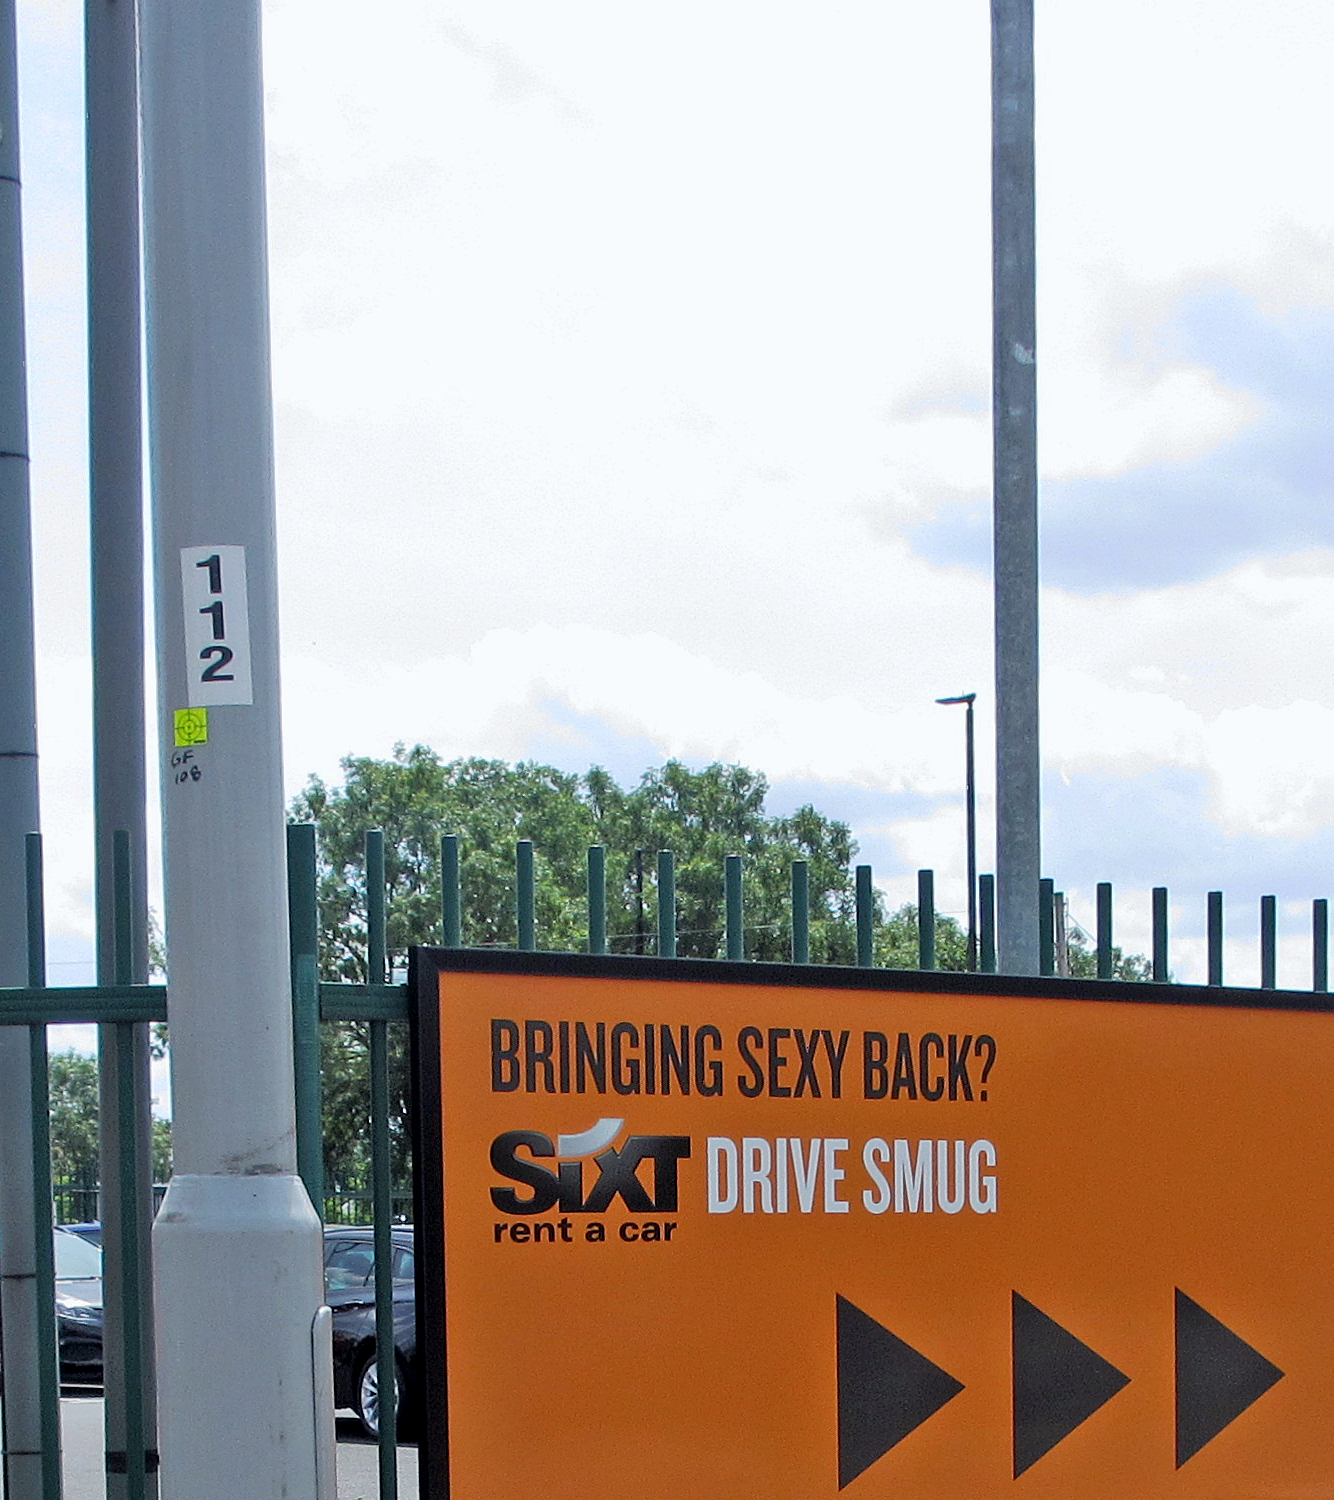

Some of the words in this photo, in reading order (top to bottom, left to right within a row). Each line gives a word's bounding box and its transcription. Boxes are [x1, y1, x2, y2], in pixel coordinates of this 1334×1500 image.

[196, 554, 235, 683] 112
[490, 1018, 723, 1097] BRINGING
[737, 1025, 851, 1098] SEXY
[863, 1031, 997, 1101] BACK?
[706, 1136, 849, 1214] DRIVE
[862, 1136, 998, 1215] SMUG
[494, 1219, 573, 1243] rent
[584, 1222, 606, 1243] a
[618, 1220, 678, 1243] car
